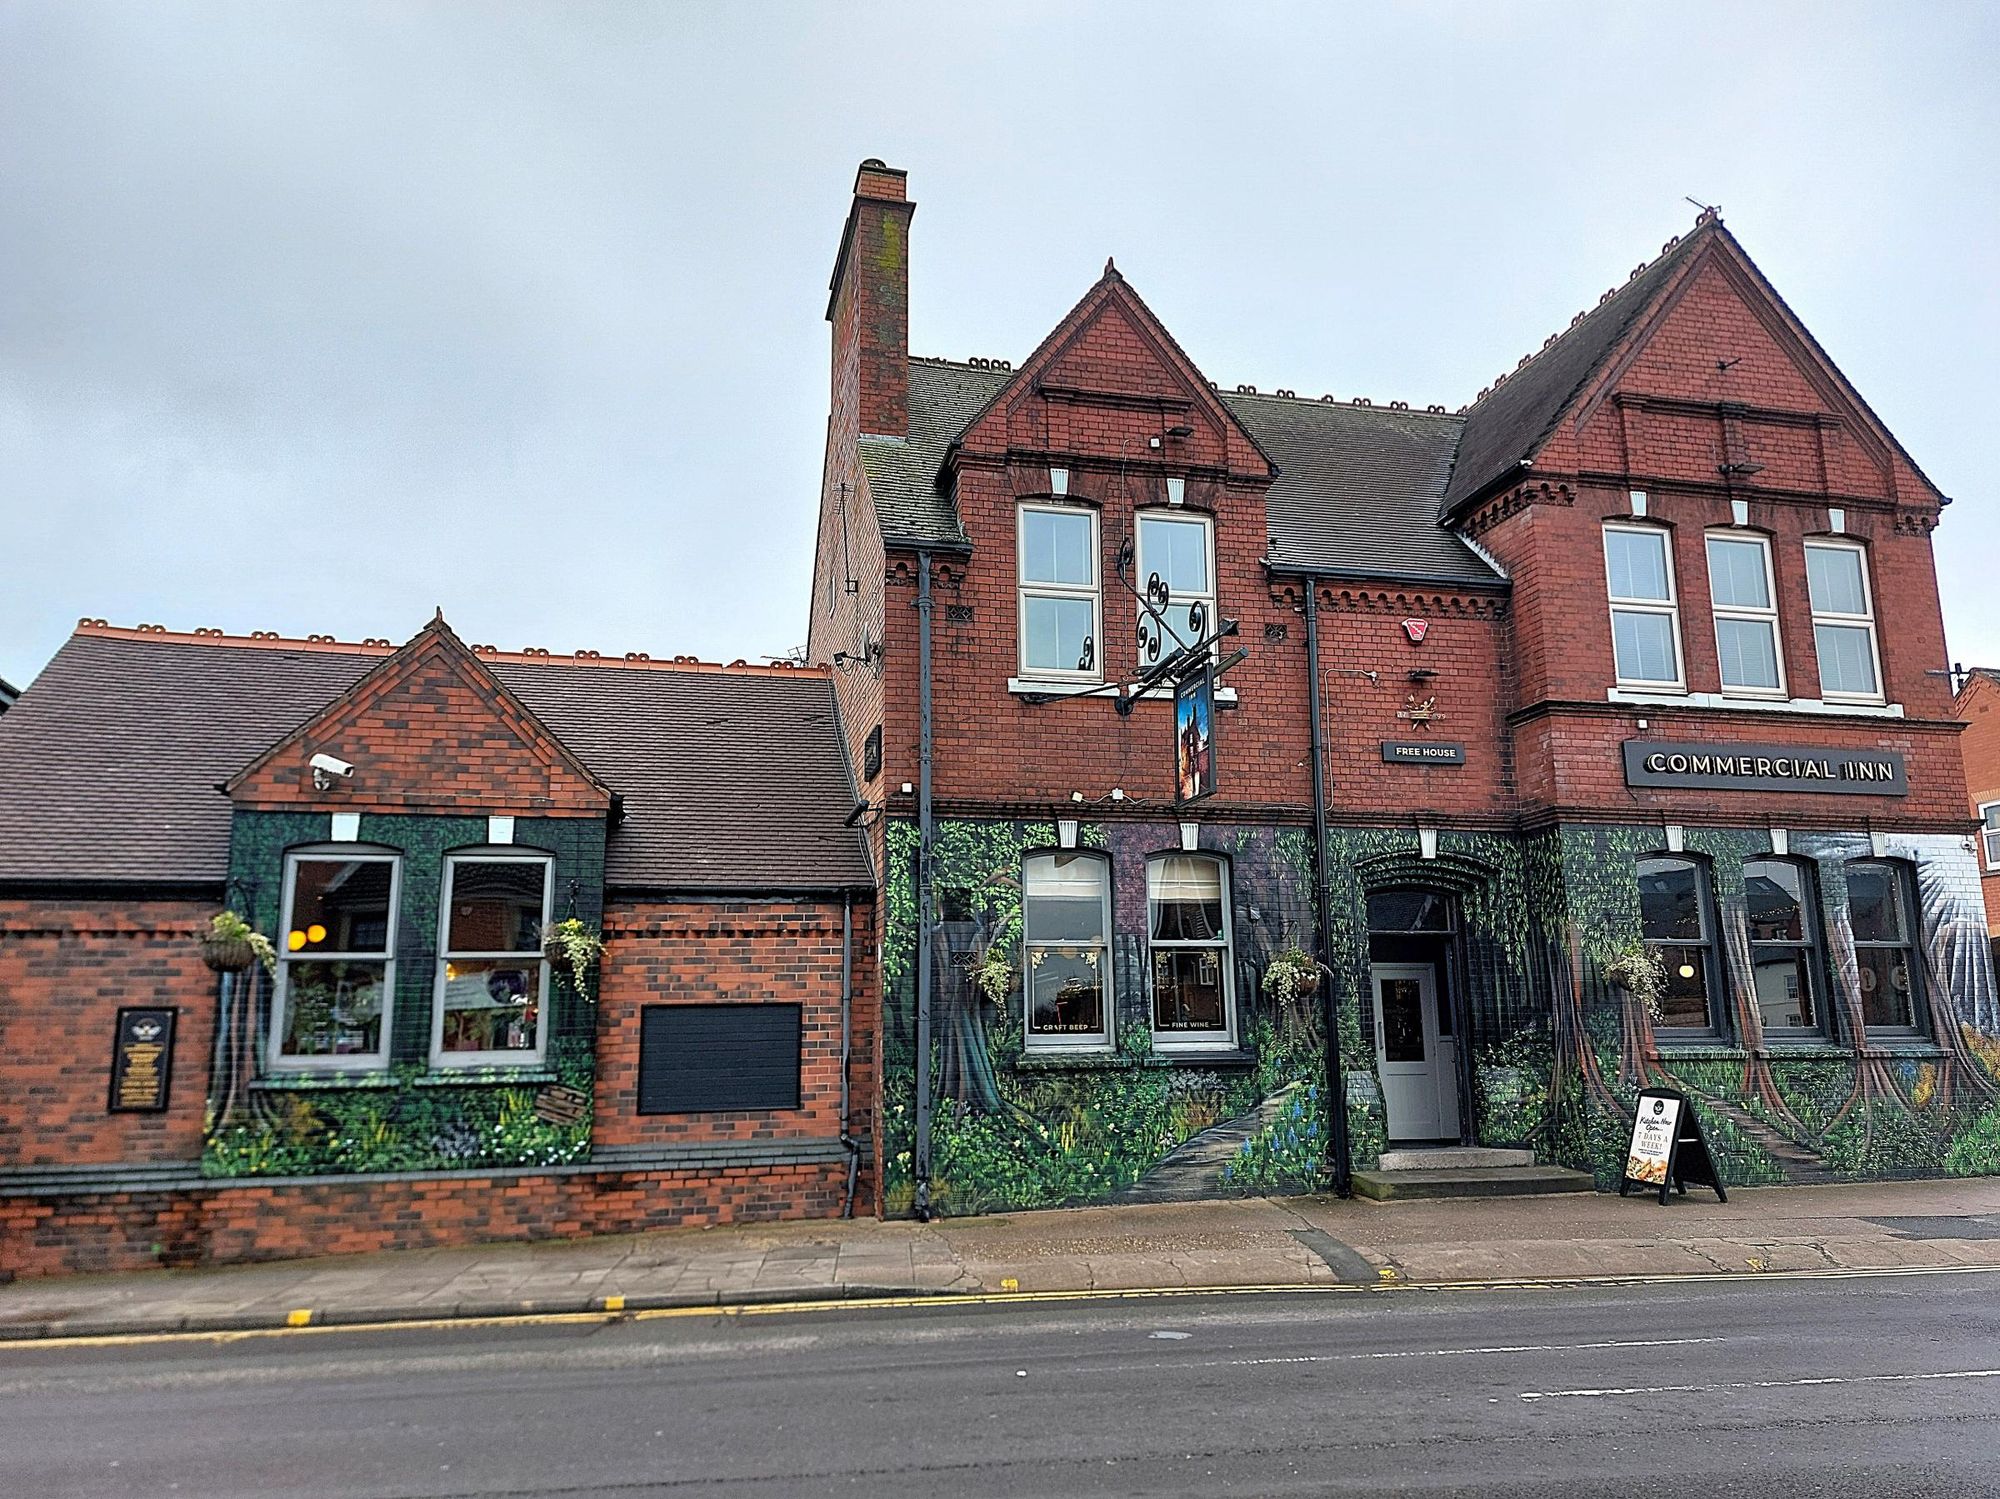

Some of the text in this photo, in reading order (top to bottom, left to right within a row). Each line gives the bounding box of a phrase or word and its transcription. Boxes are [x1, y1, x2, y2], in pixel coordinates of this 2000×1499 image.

[1180, 678, 1204, 698] COMMERCIAL
[1396, 747, 1456, 757] FREE HOUSE
[1646, 753, 1893, 780] COMMERCIAL INN
[1639, 1116, 1672, 1125] Kitchen Now
[1643, 1132, 1661, 1141] DAYS
